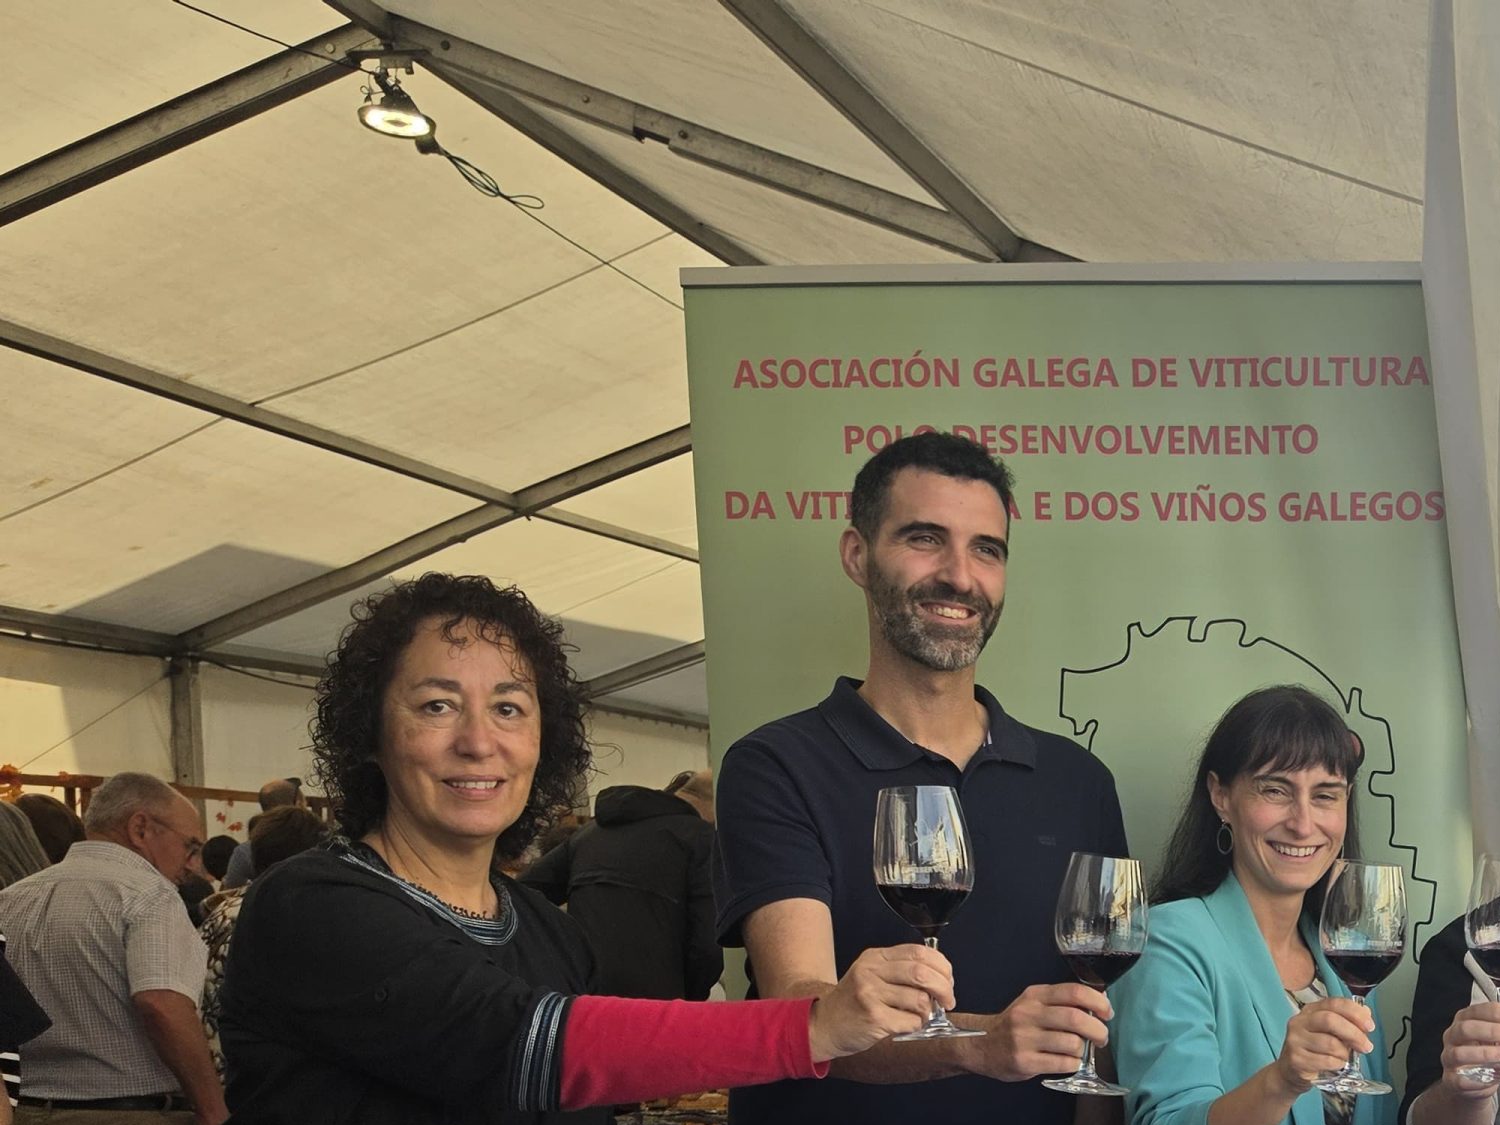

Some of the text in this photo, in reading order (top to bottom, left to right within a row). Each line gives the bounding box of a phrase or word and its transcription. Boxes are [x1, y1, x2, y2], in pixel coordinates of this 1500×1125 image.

[733, 350, 1430, 388] ASOCIACIÓN GALEGA DE VITICULTURA
[844, 425, 934, 454] PO
[724, 491, 776, 520] DA
[1034, 491, 1051, 520] E
[1065, 491, 1140, 522] DOS
[1155, 484, 1269, 523] VIÑOS
[1278, 490, 1445, 523] GALEGOS
